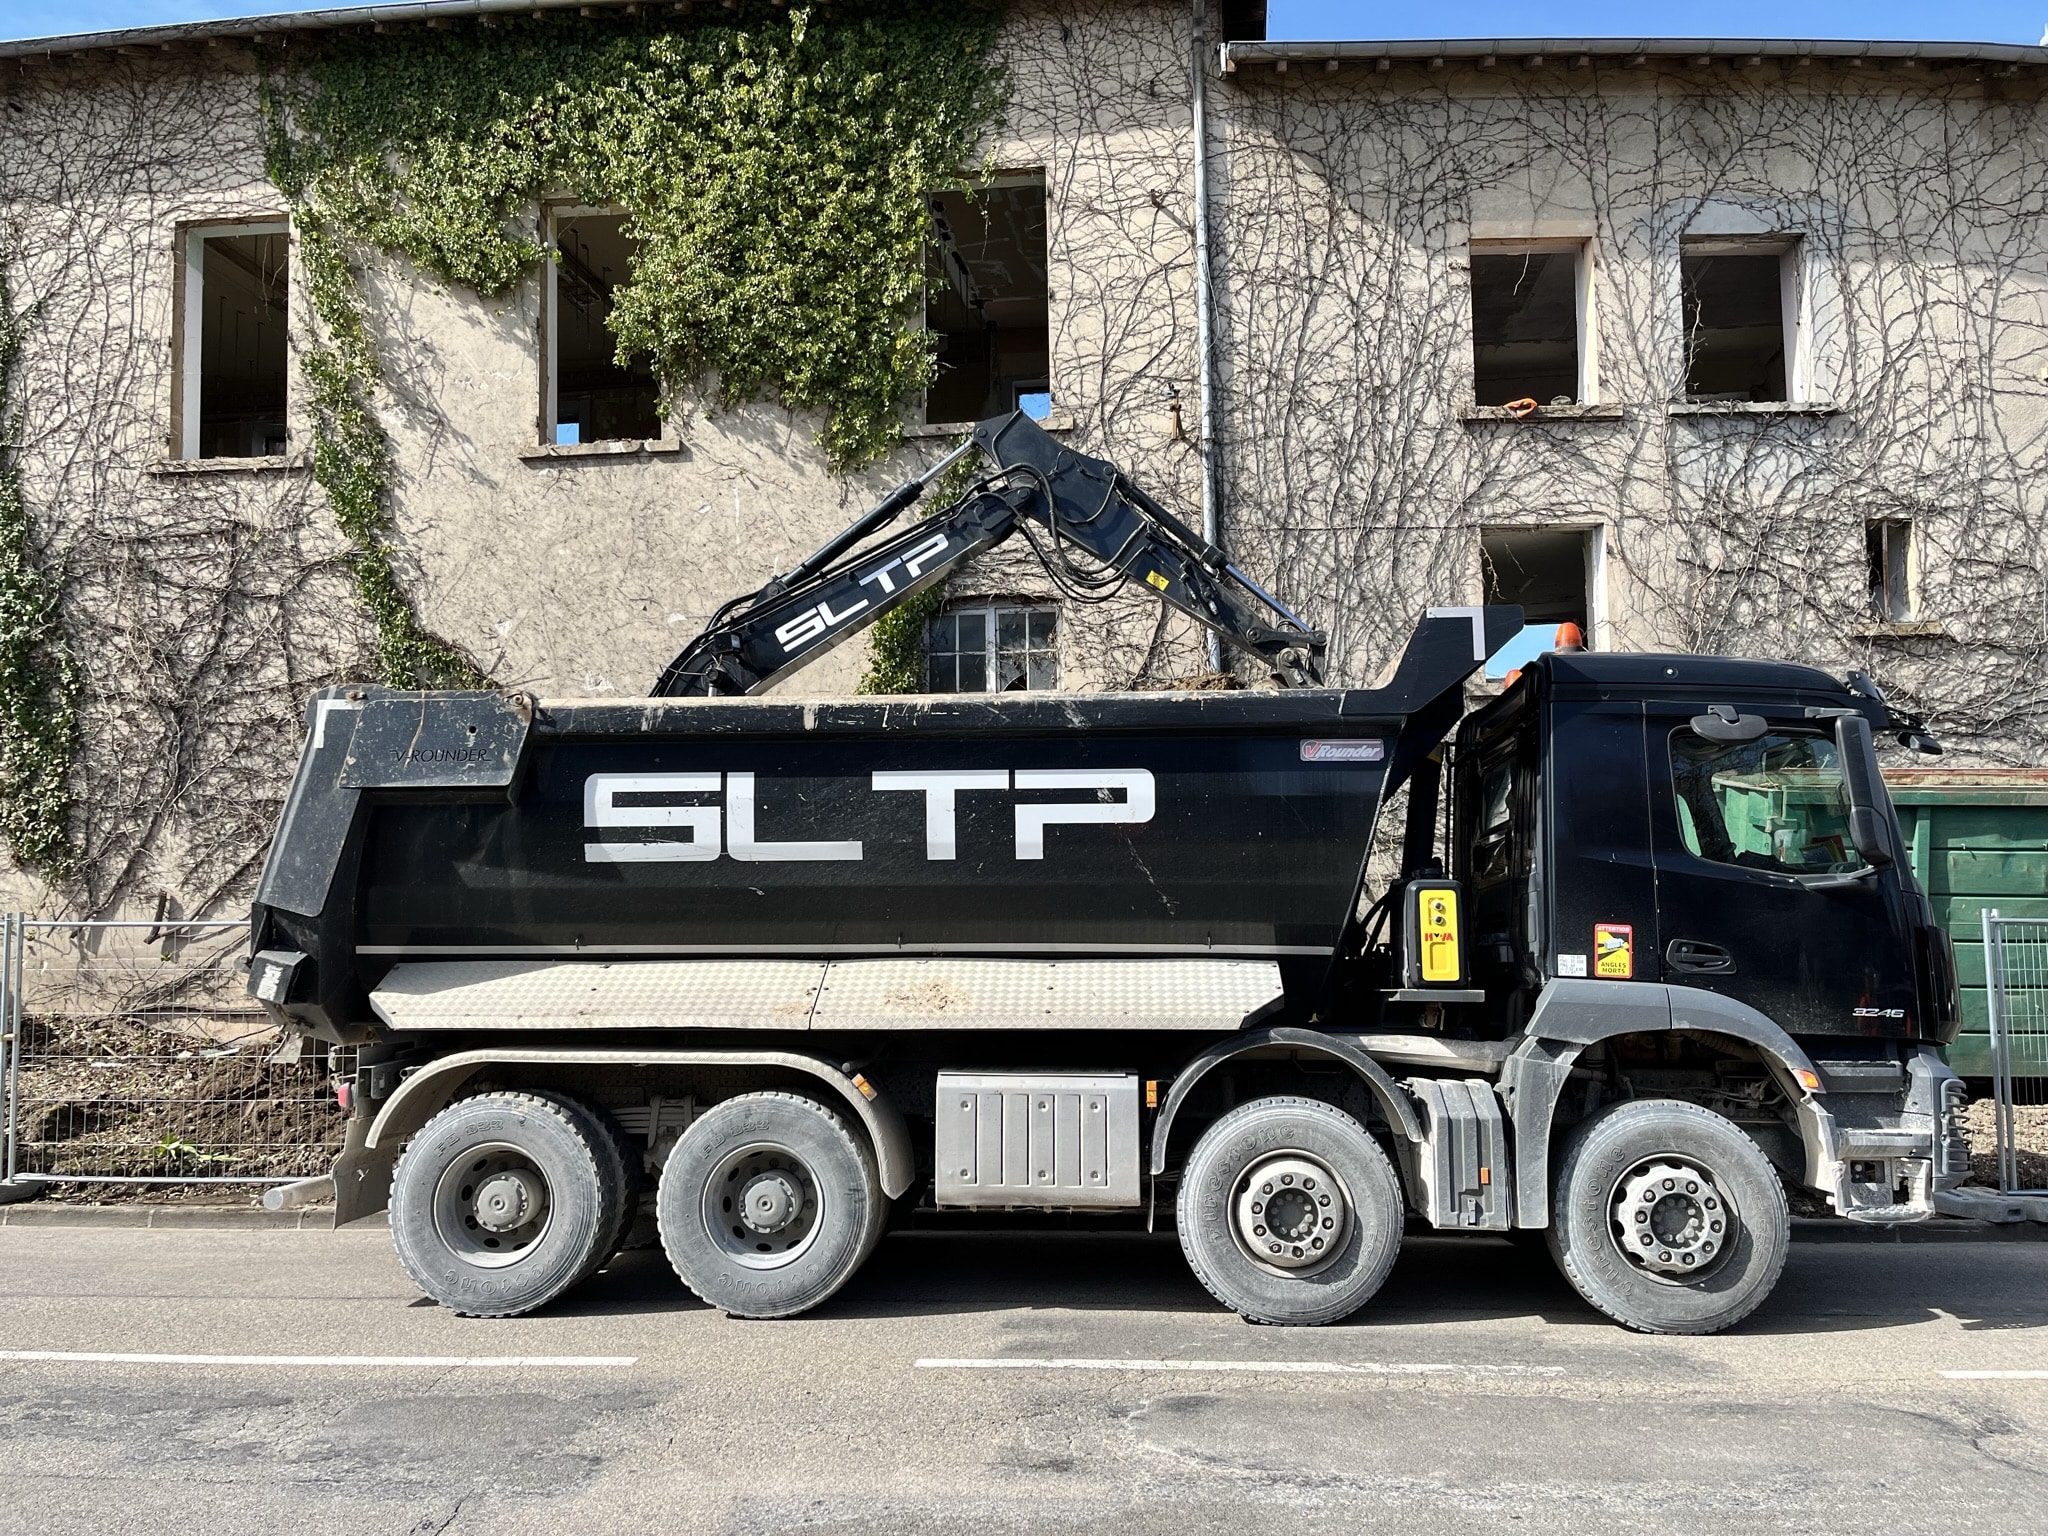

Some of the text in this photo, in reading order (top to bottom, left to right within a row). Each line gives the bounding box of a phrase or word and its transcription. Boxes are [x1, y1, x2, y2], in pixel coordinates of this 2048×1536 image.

[774, 533, 949, 653] SLTP
[584, 768, 1156, 862] SLTP
[1852, 1007, 1905, 1018] 3246
